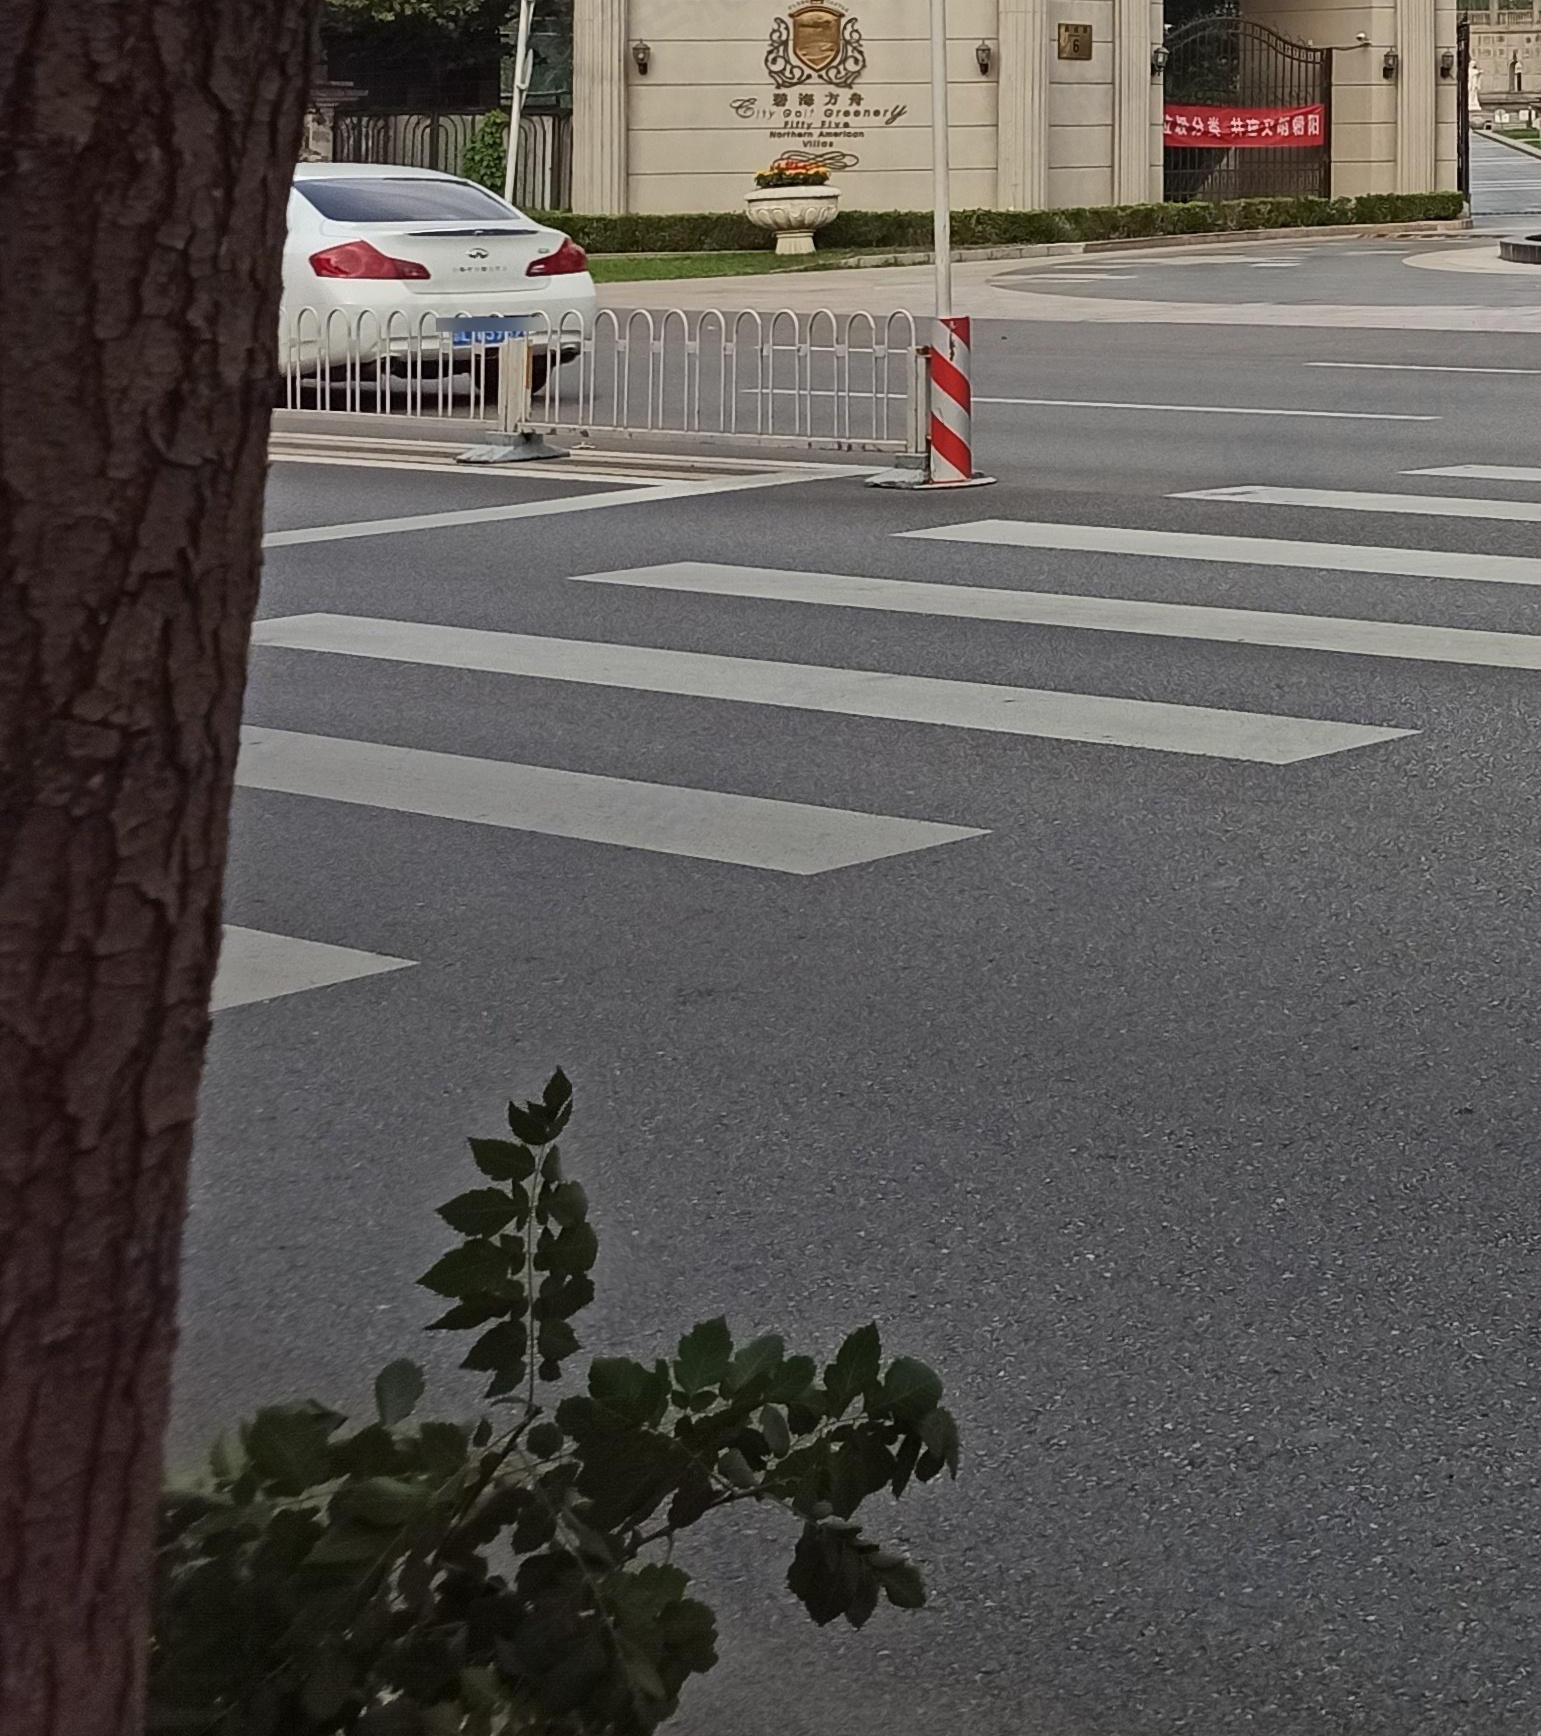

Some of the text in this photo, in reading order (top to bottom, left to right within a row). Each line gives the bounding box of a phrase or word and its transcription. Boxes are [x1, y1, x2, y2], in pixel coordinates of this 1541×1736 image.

[772, 92, 864, 107] 碧海方舟
[821, 120, 850, 129] Five
